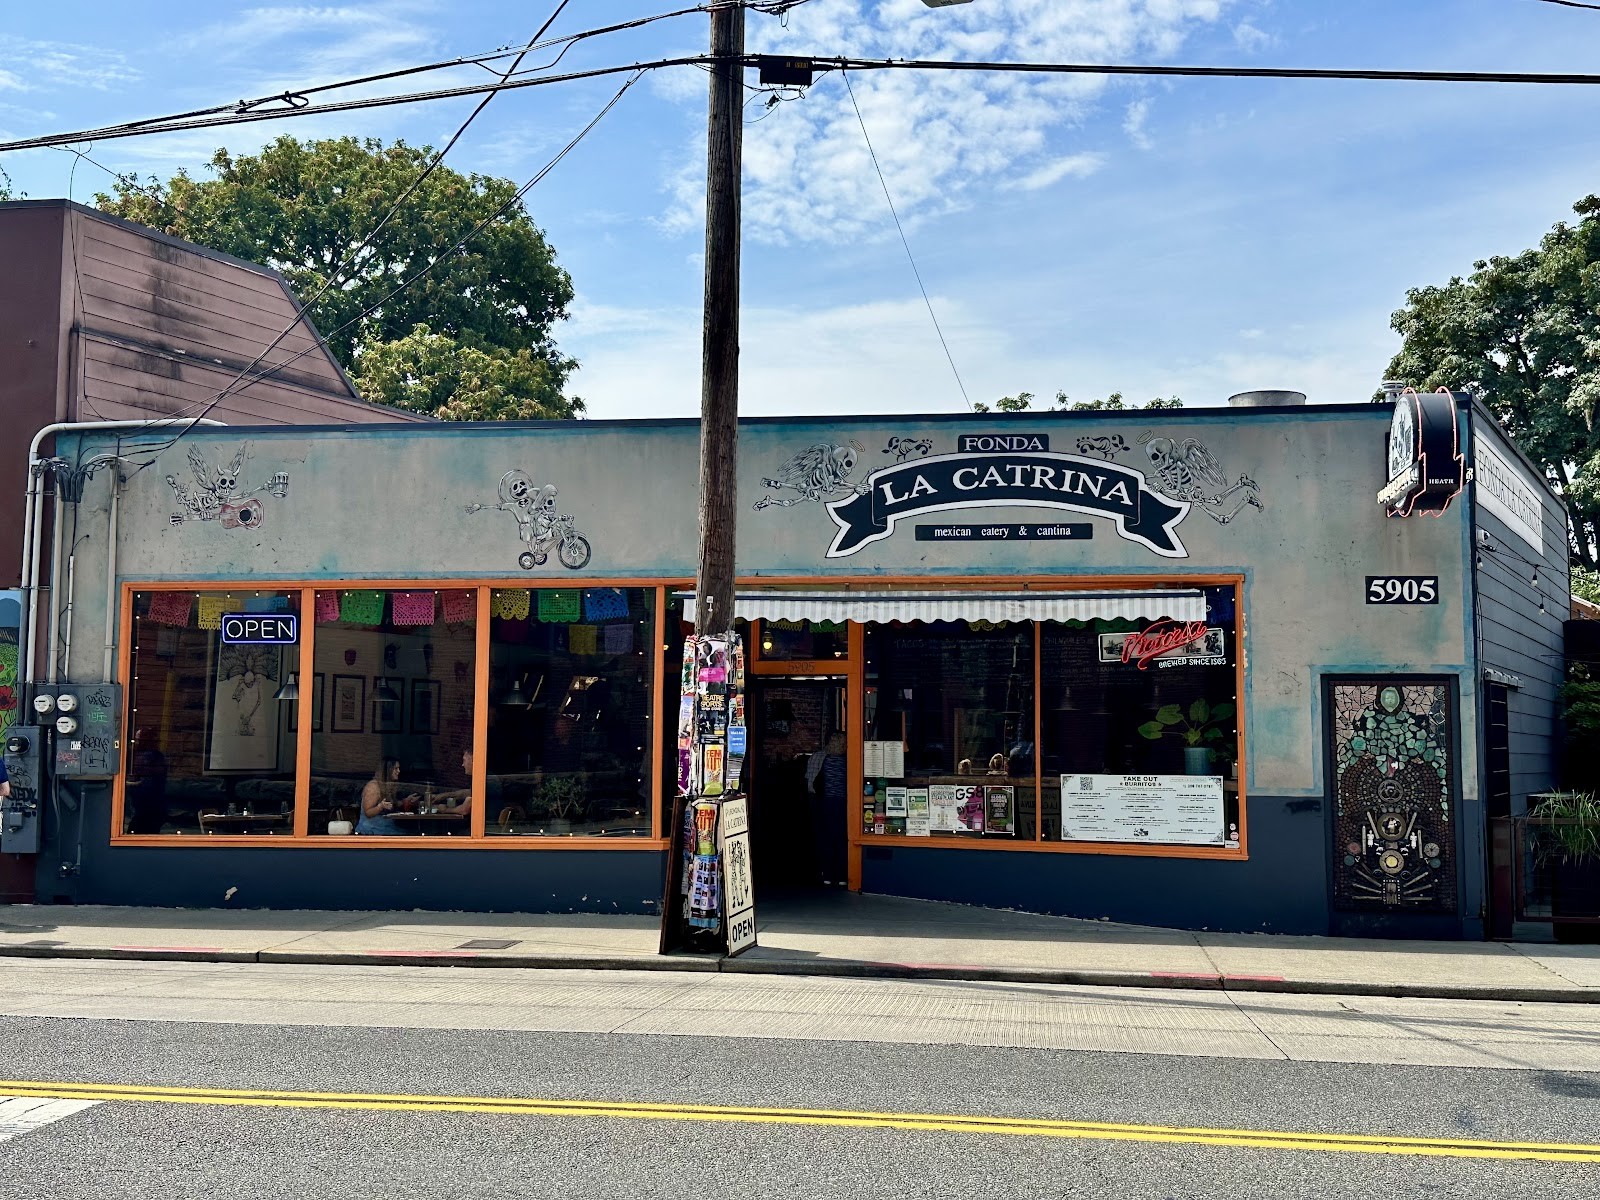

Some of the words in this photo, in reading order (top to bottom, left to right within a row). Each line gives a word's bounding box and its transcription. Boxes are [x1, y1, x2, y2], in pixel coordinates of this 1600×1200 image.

[963, 437, 1043, 451] FONDA
[879, 473, 938, 506] LA
[952, 464, 1134, 505] CATRINA
[934, 525, 972, 537] mexican
[981, 525, 1009, 539] eatery
[1018, 525, 1028, 536] &
[1036, 525, 1072, 536] cantina
[1369, 579, 1436, 602] 5905
[225, 619, 294, 639] OPEN
[1121, 620, 1208, 667] Victoria
[787, 661, 816, 673] 5905
[1158, 658, 1187, 669] BREWED
[1188, 658, 1210, 666] SINCE
[732, 916, 753, 943] OPEN
